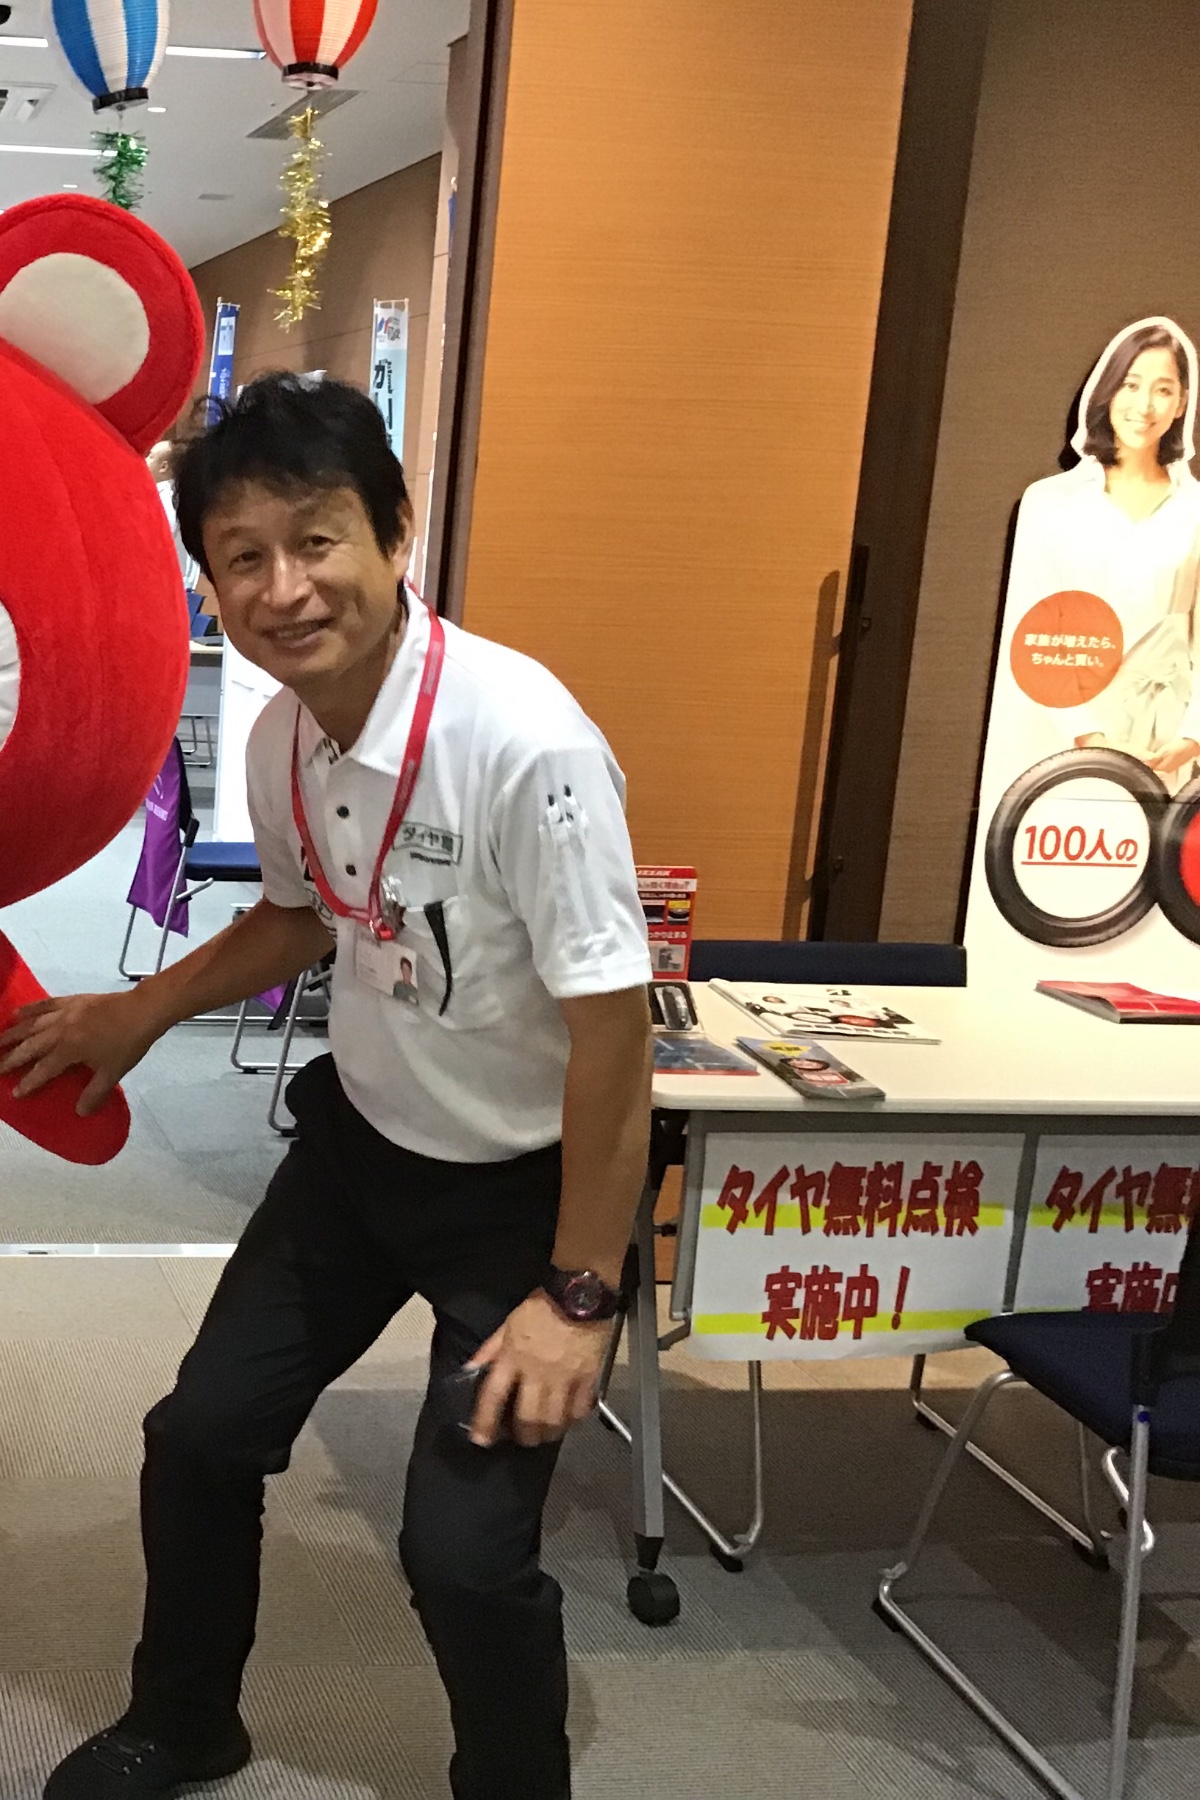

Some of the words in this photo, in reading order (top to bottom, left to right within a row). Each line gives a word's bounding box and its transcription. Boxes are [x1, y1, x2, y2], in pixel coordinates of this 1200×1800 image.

[403, 826, 454, 852] タイヤ
[1025, 825, 1138, 861] 100人の
[716, 1159, 985, 1239] タイヤ無料点検
[760, 1263, 912, 1341] 実施中！
